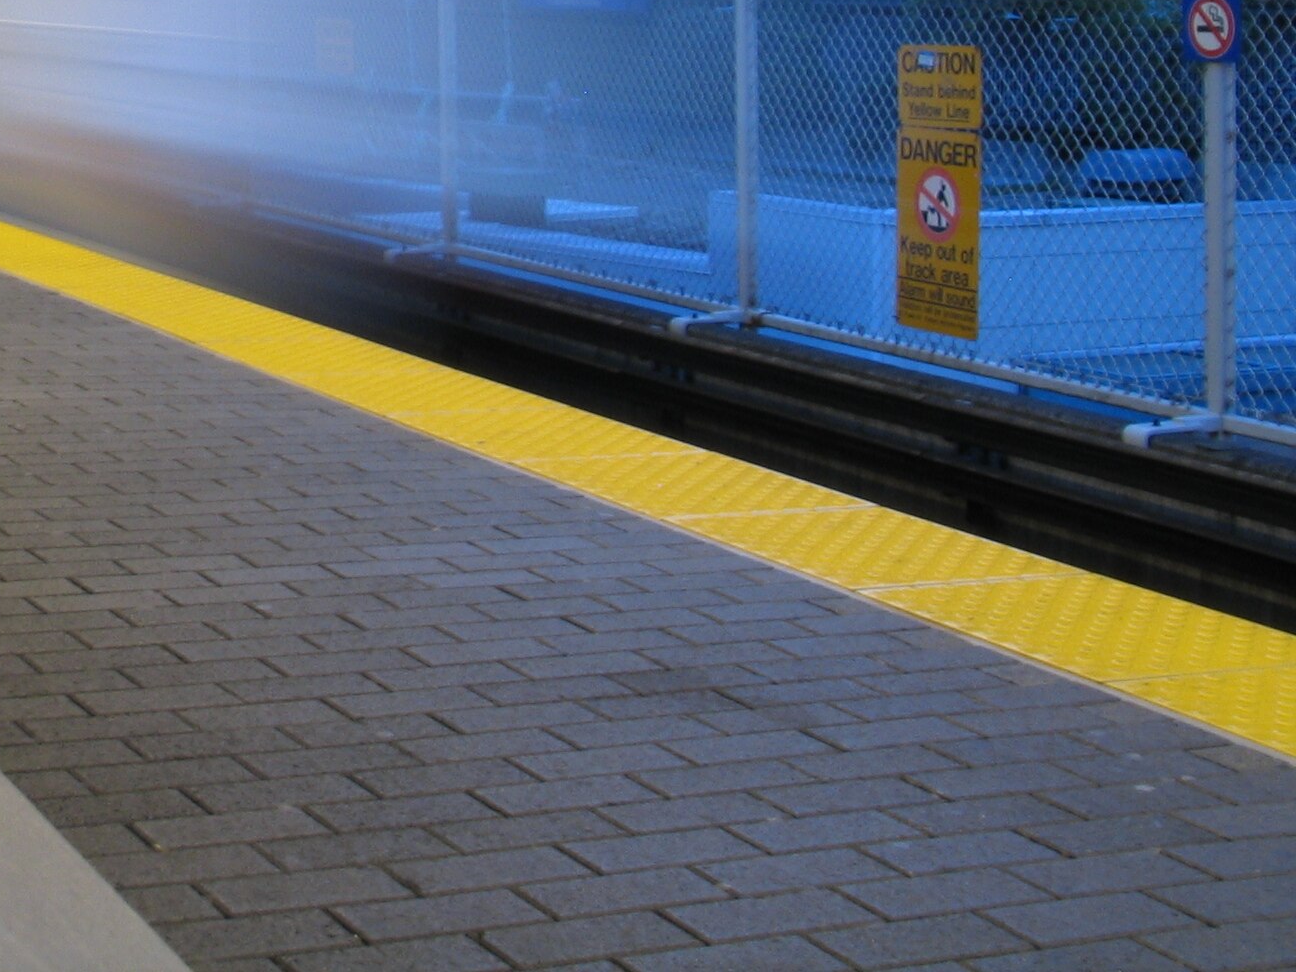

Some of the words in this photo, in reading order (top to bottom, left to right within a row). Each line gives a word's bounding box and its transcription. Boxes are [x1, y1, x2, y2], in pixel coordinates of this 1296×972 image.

[908, 102, 942, 118] Yellow
[946, 103, 970, 119] Line
[900, 137, 977, 168] DANGER
[900, 235, 932, 260] Keep
[936, 244, 956, 262] out
[961, 246, 975, 265] of
[905, 260, 936, 280] track
[941, 269, 969, 287] area
